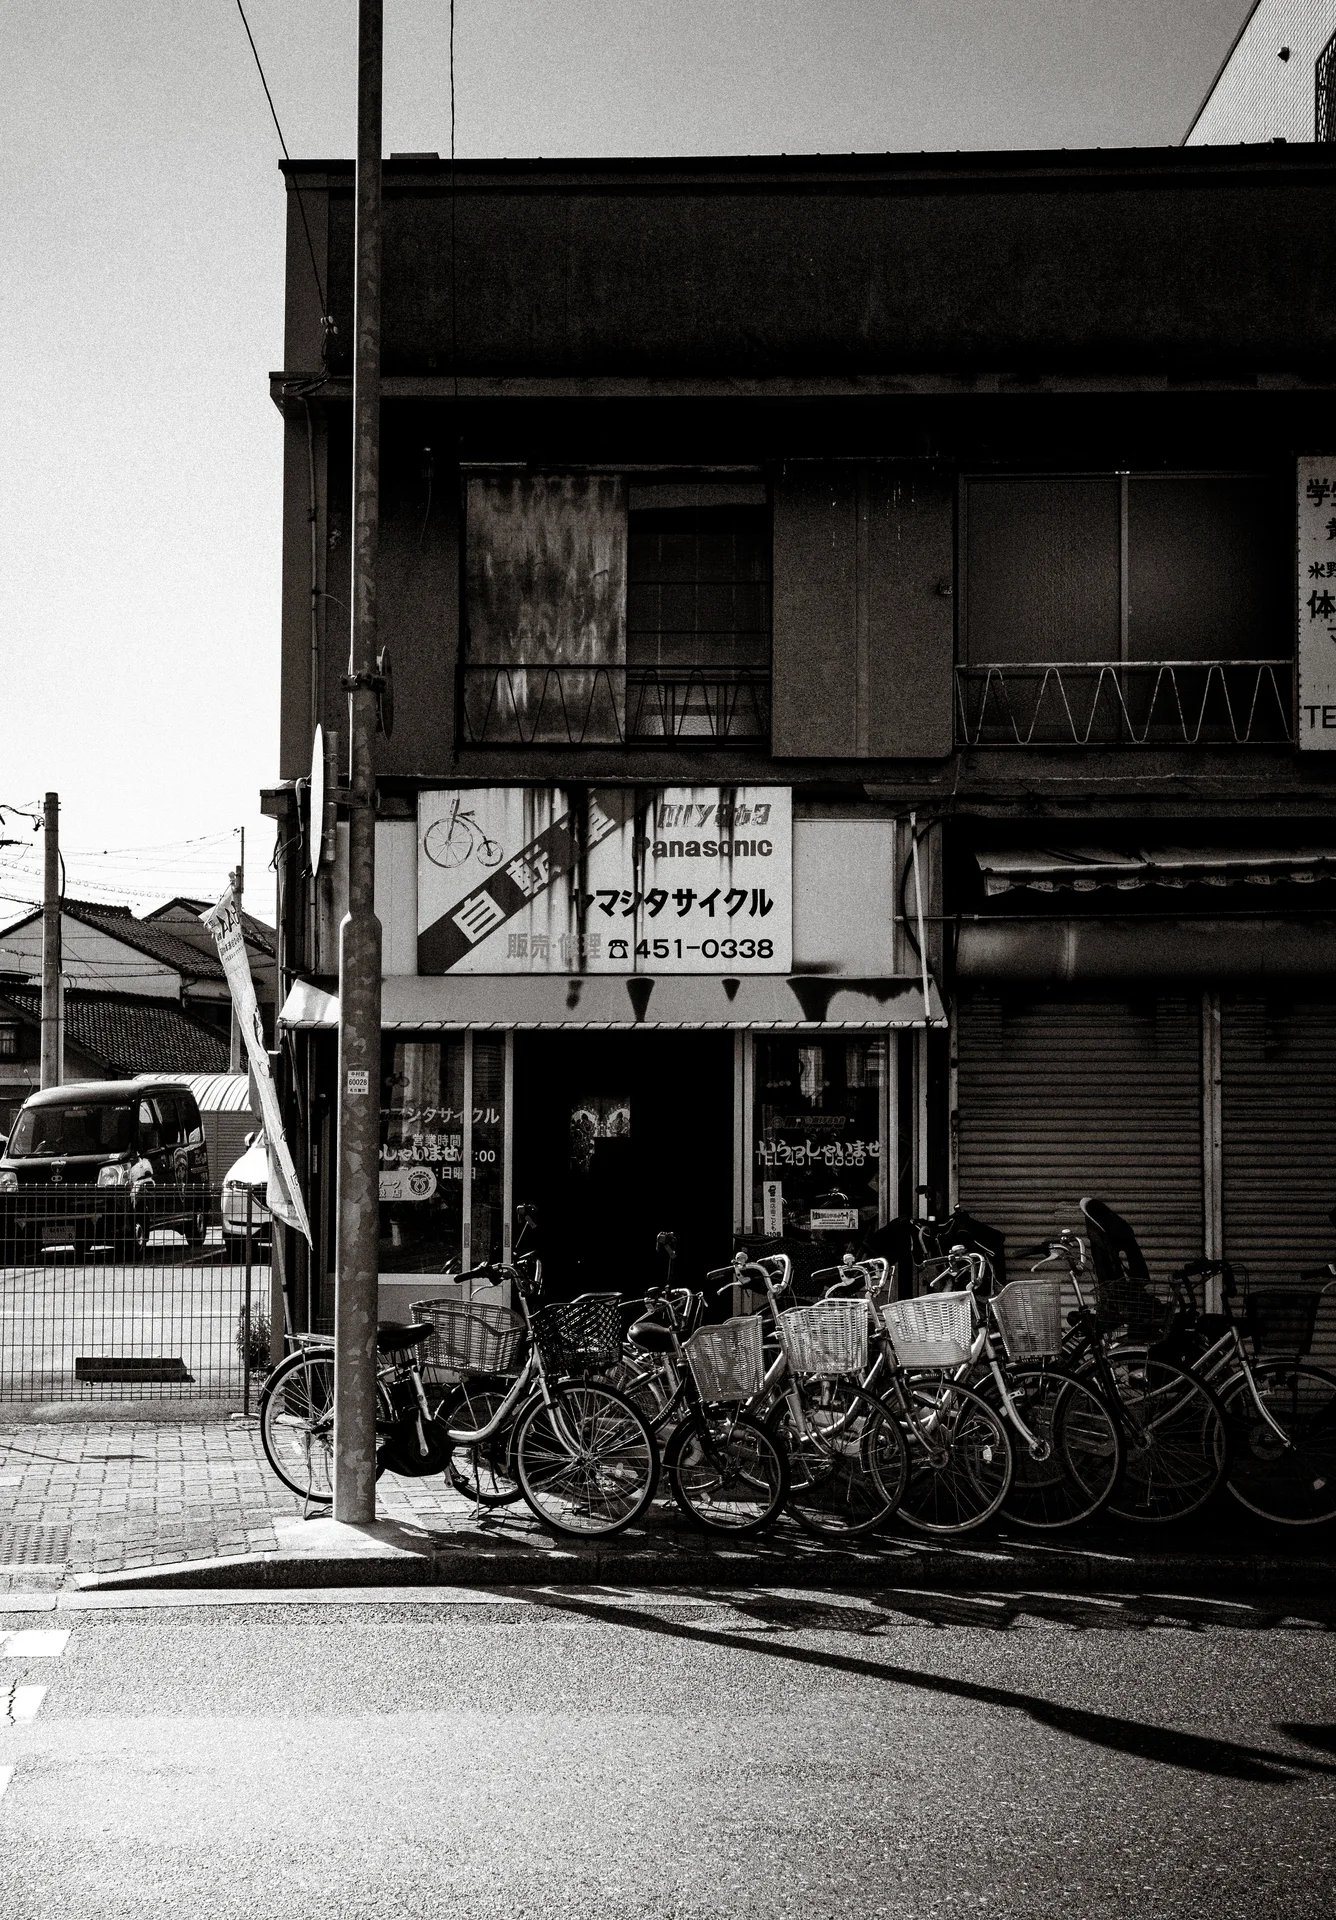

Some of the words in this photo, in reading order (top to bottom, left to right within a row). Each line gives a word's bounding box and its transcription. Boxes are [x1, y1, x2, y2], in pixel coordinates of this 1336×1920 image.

[1306, 477, 1336, 508] 学
[632, 836, 773, 857] Panasonic
[568, 888, 774, 918] ヤマシタサイクル
[634, 938, 774, 959] 451-0338
[348, 1078, 368, 1086] 60028
[412, 1133, 461, 1147] 営業時間
[758, 1139, 883, 1158] いらっしゃいませ
